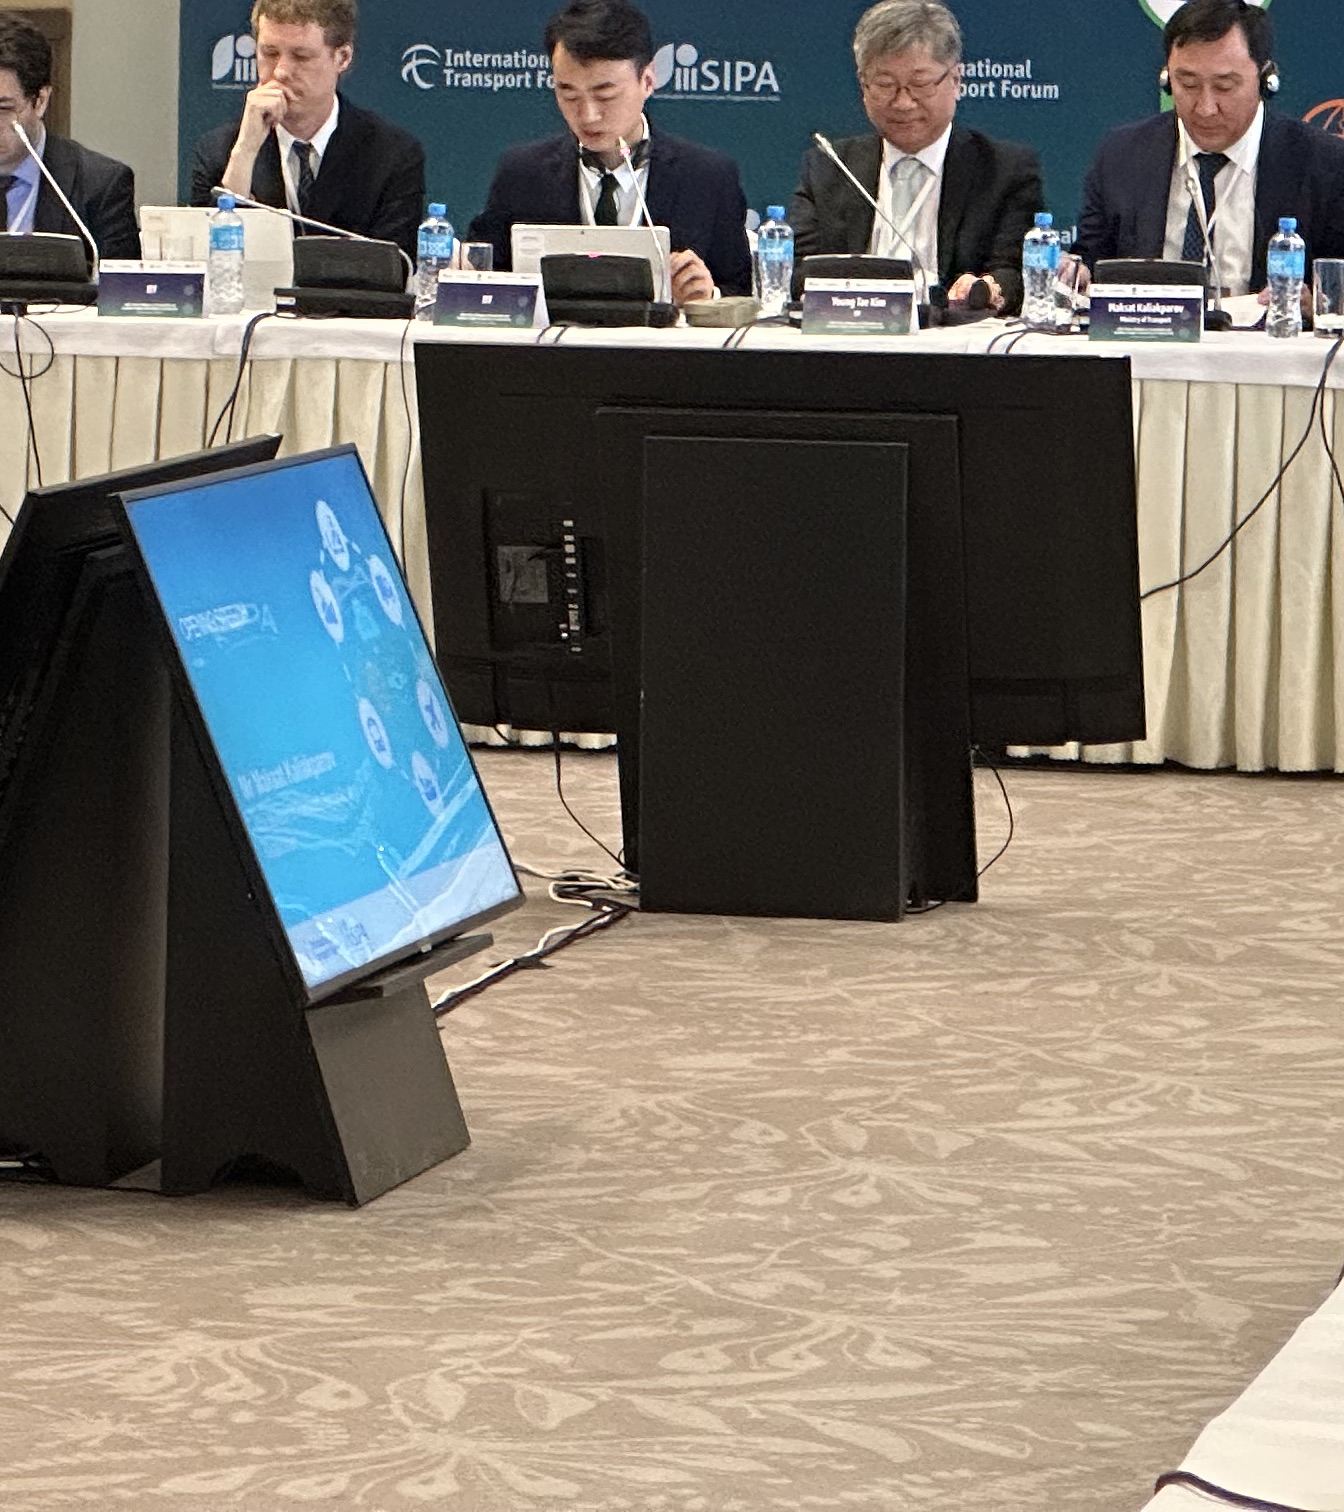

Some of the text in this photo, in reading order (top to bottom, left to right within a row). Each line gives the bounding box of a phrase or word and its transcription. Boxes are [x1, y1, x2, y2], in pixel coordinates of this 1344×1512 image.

[443, 69, 531, 91] Transport
[700, 60, 779, 92] SIPA
[1001, 80, 1059, 98] Forum
